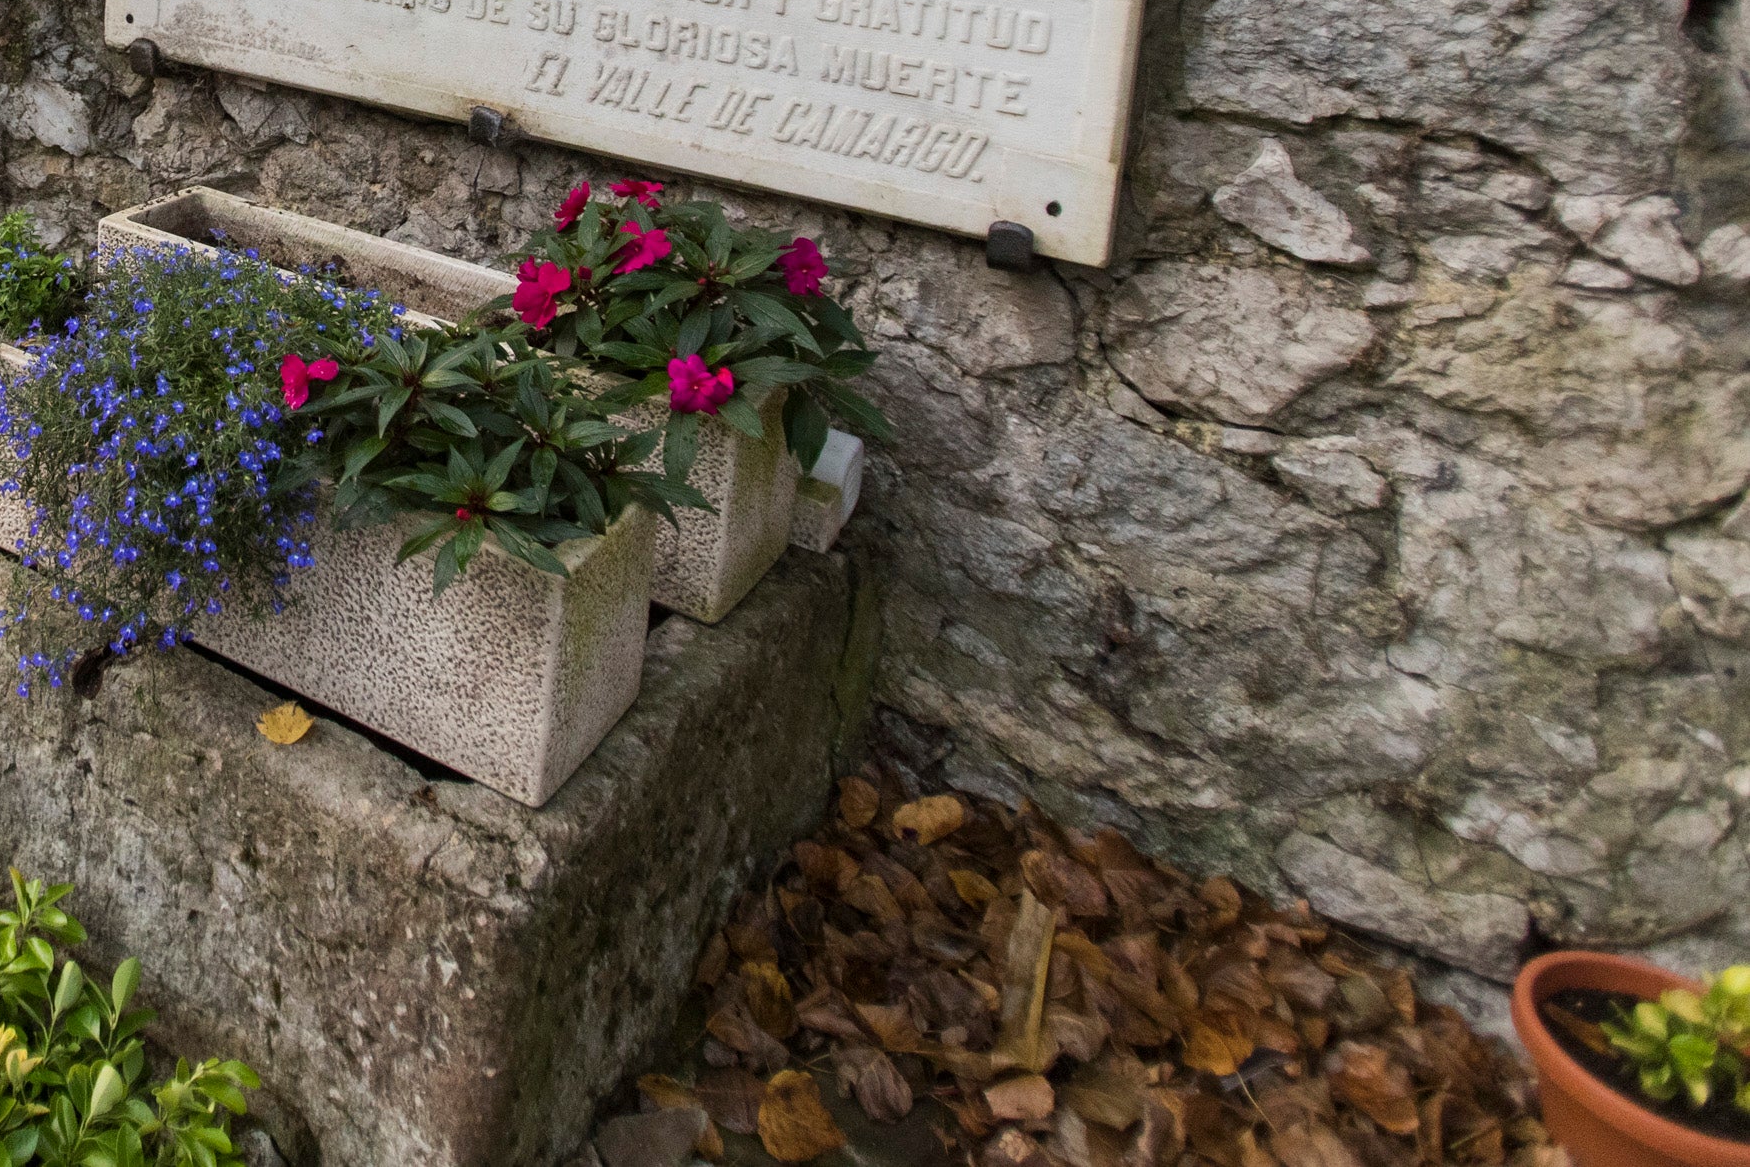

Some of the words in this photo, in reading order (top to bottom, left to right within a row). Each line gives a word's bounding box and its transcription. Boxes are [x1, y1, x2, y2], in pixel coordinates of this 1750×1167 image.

[524, 51, 571, 97] EL
[588, 63, 711, 124] VALLE
[706, 86, 776, 136] DE
[770, 96, 991, 183] CAMARGO.
[593, 8, 801, 77] GLORIOSA
[819, 43, 1032, 117] MUERTE
